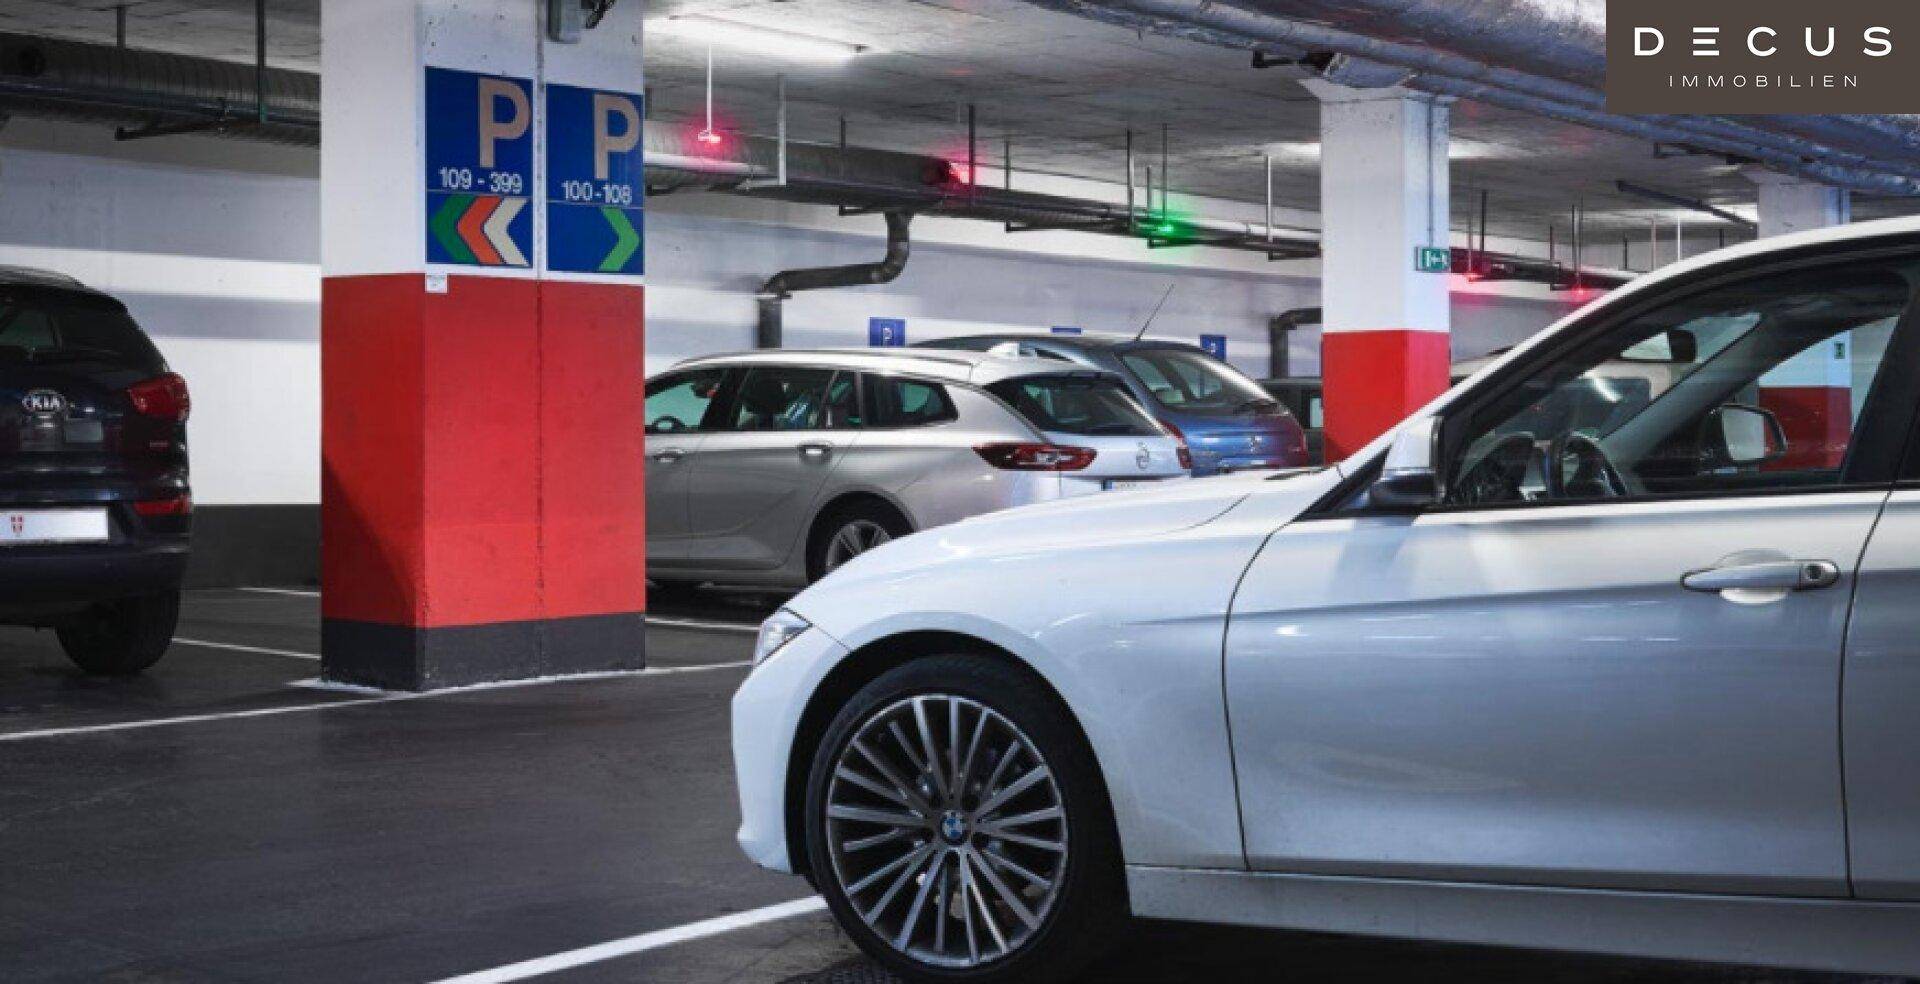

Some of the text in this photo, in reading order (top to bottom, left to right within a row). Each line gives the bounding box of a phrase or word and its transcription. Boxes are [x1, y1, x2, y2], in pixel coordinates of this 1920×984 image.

[478, 77, 531, 168] P
[593, 94, 640, 180] P
[438, 166, 472, 190] 109
[489, 171, 523, 195] 399
[31, 394, 61, 409] KIA
